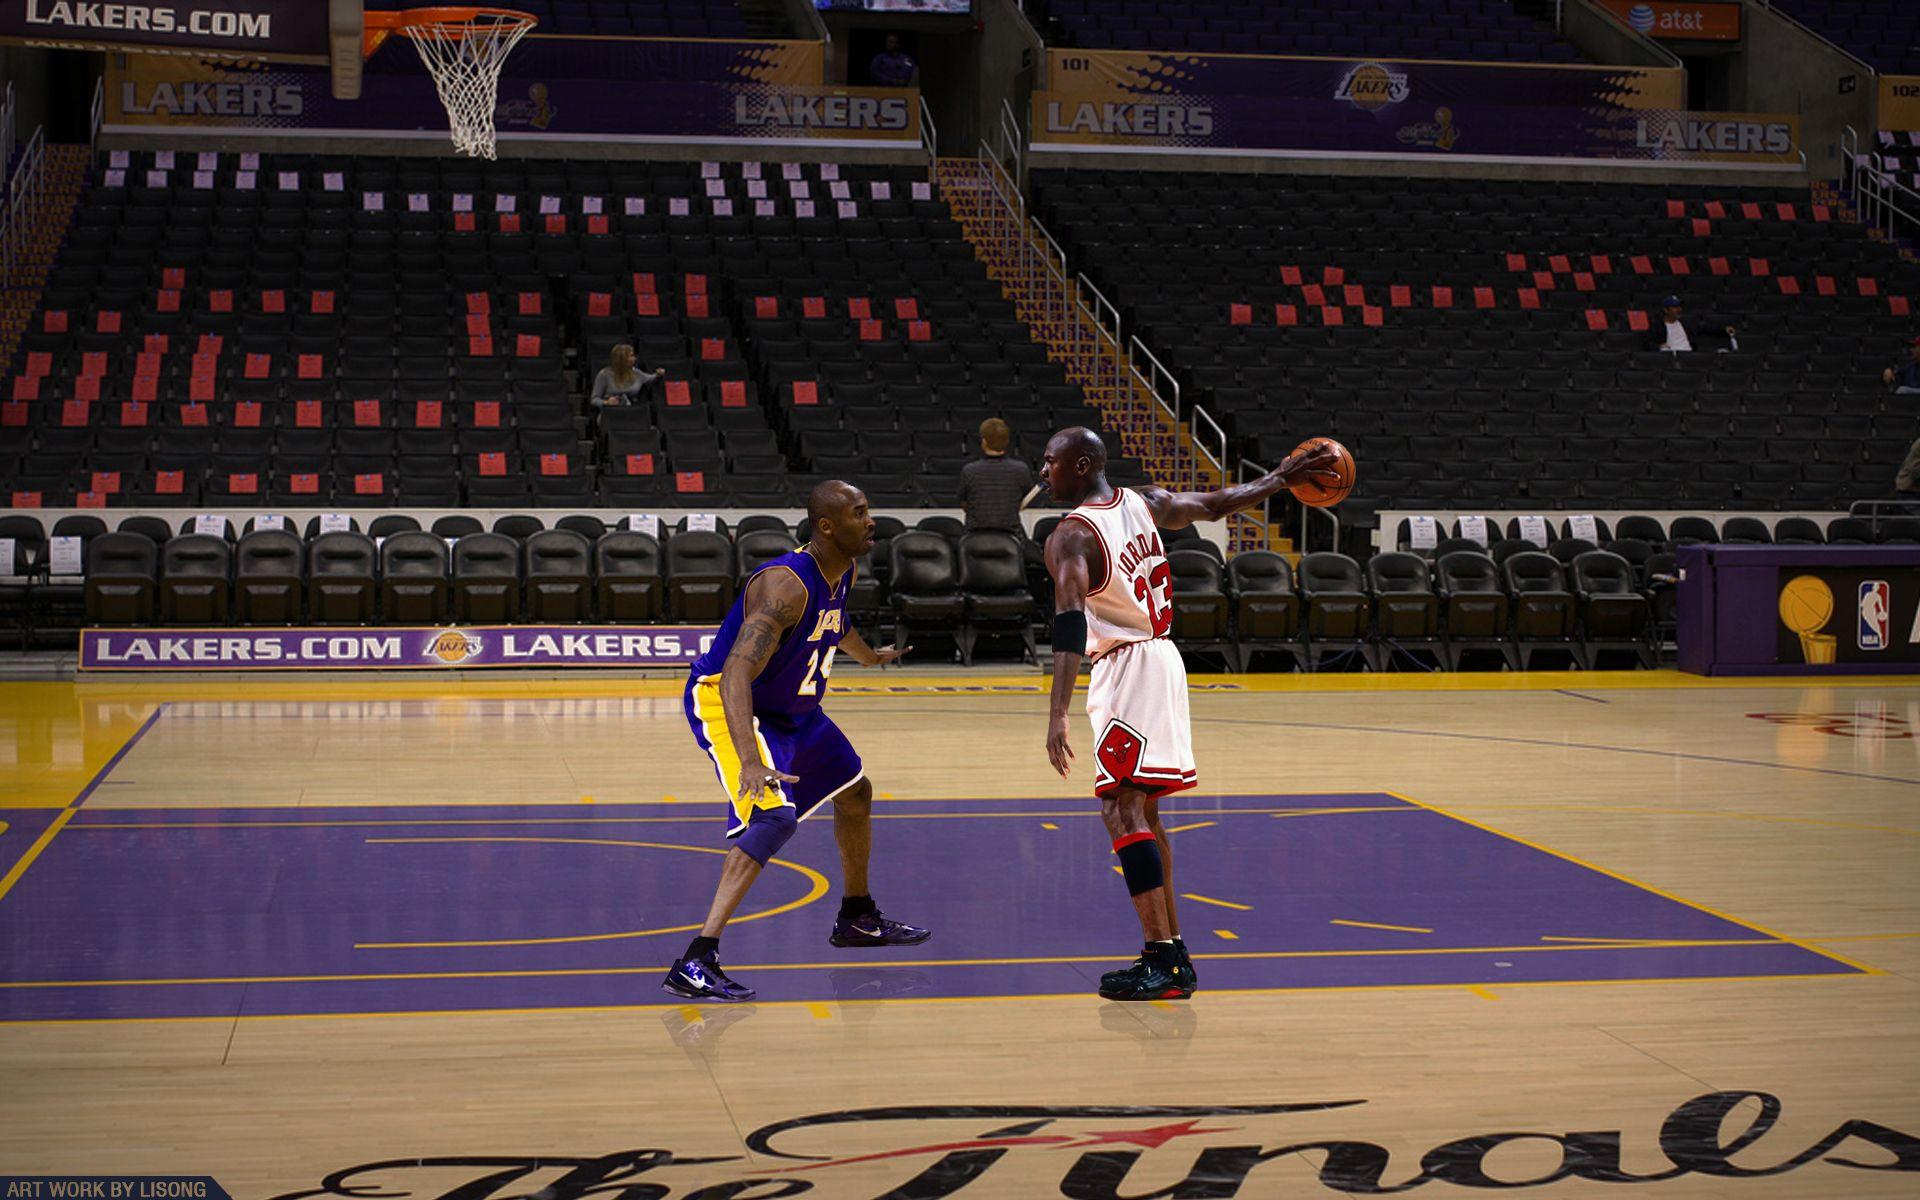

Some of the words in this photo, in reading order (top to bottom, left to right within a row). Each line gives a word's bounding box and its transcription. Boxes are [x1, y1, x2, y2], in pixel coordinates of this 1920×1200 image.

[26, 0, 271, 38] LAKERS.COM
[1660, 10, 1703, 31] at&t
[1062, 58, 1089, 71] 101
[121, 81, 304, 116] LAKERS
[1337, 74, 1409, 101] LAKERS
[735, 94, 909, 129] LAKERS
[1047, 101, 1214, 137] LAKERS
[1635, 119, 1792, 153] LAKERS
[1134, 561, 1174, 638] 23
[97, 637, 402, 661] LAKERS.COM
[503, 635, 717, 657] LAKERS.C
[797, 645, 837, 696] 24
